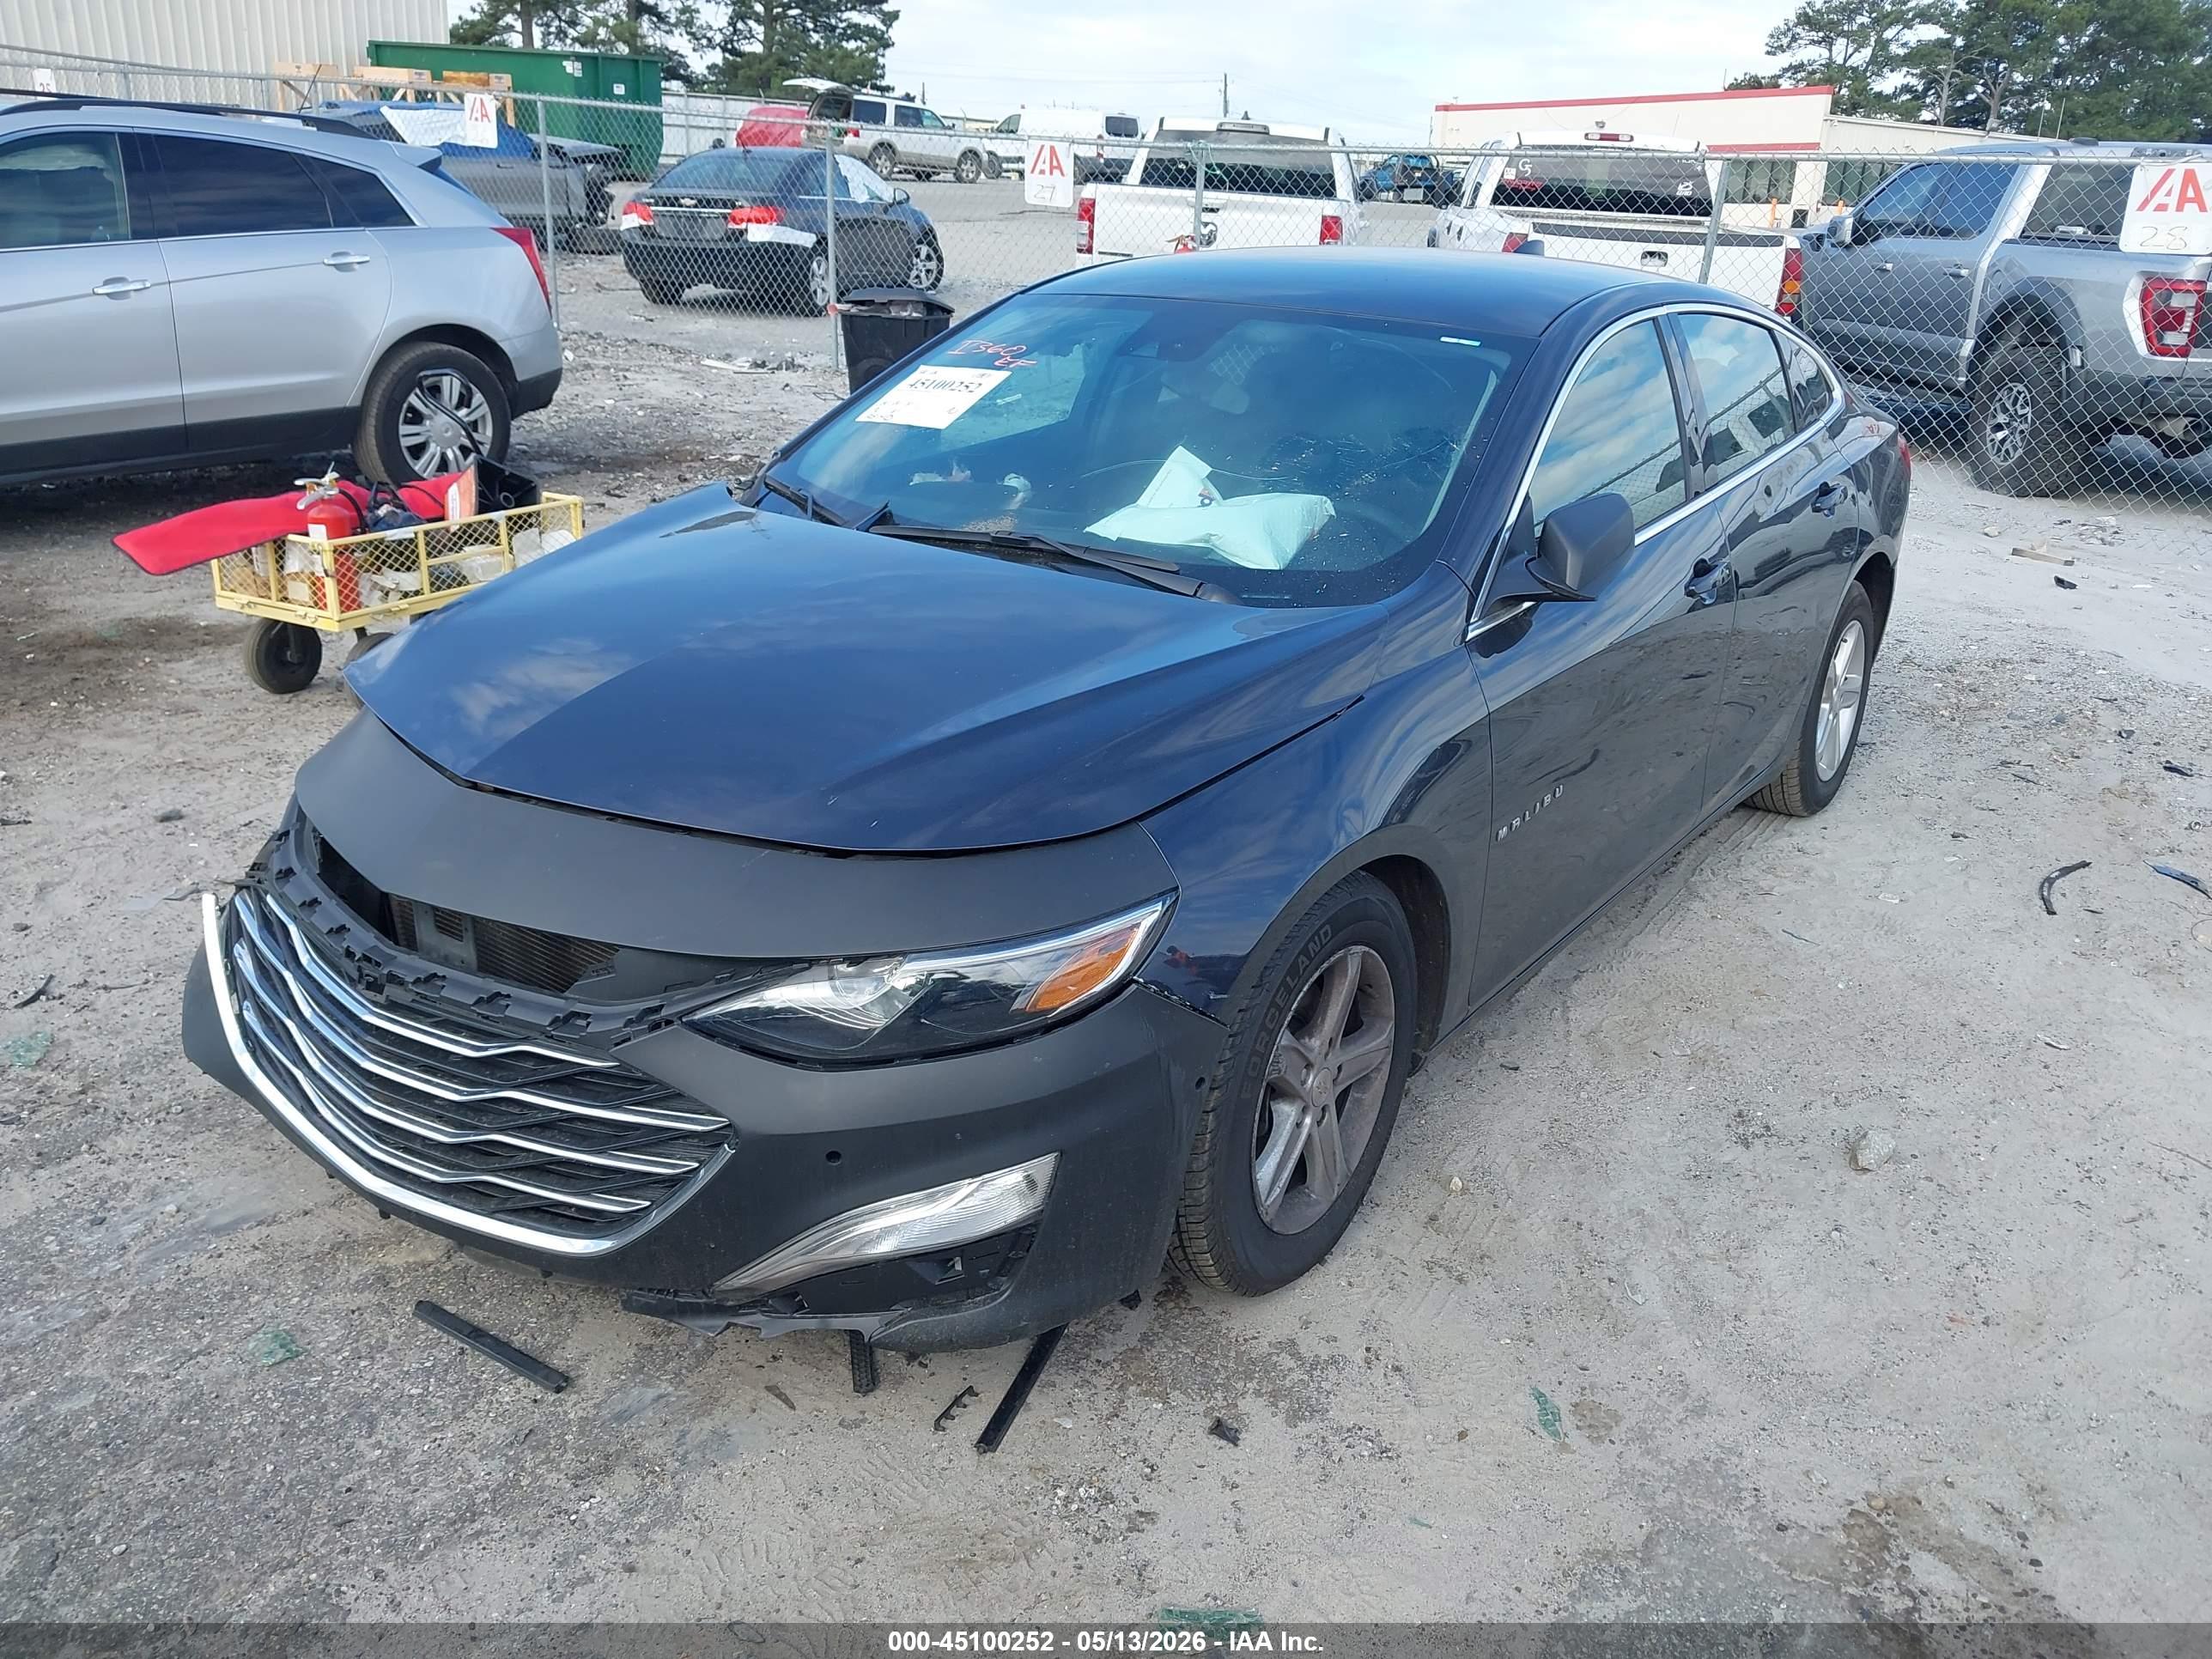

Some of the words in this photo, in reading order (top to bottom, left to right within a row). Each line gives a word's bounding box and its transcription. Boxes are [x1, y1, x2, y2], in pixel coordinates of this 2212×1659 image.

[1033, 184, 1056, 203] 27
[2140, 226, 2188, 251] 28
[908, 378, 983, 393] 45100252
[1497, 784, 1563, 842] MALIBU
[1241, 923, 1334, 1100] FORCELAND
